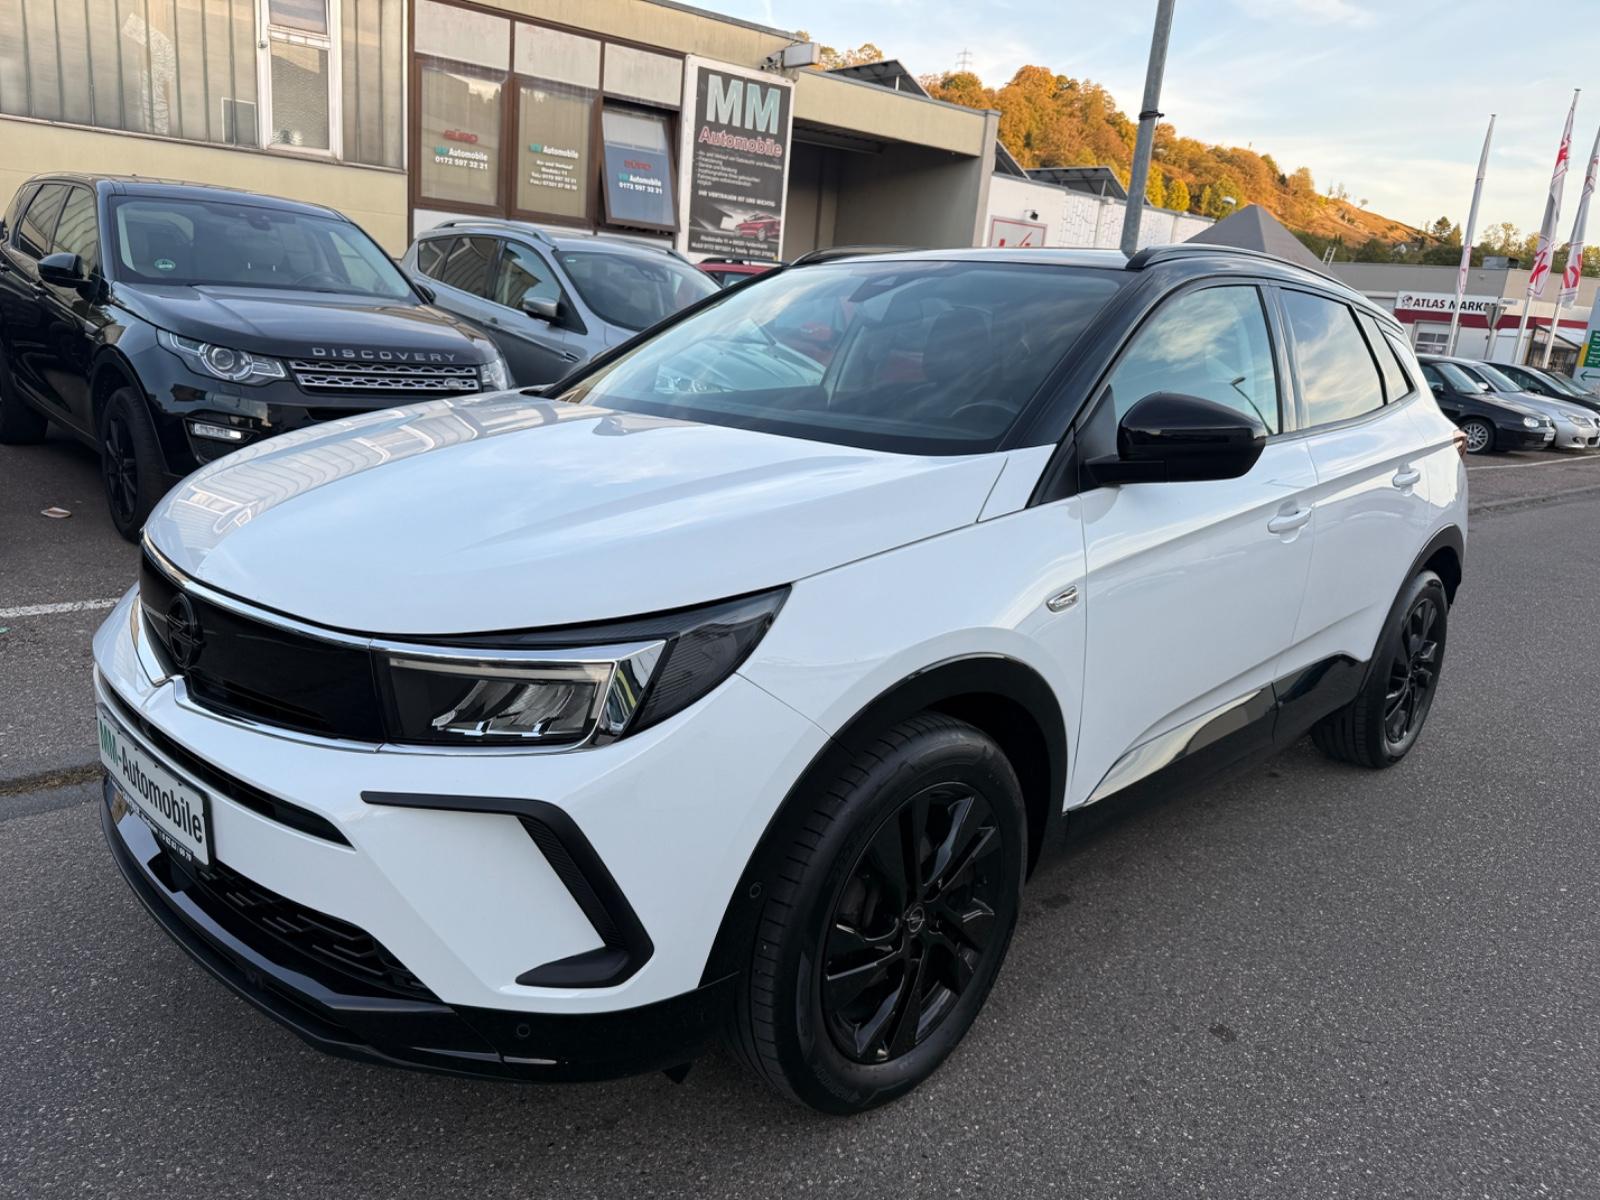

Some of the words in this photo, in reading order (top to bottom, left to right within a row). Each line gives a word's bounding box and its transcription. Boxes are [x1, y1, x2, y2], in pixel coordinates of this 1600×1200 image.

[706, 74, 781, 135] MM
[698, 126, 783, 158] Automobile
[448, 147, 489, 161] Automobile
[543, 145, 580, 160] Automobile
[435, 155, 453, 165] 0172
[629, 174, 662, 188] Automobile
[1413, 298, 1446, 309] ATLAS
[312, 347, 456, 362] DISCOVERY
